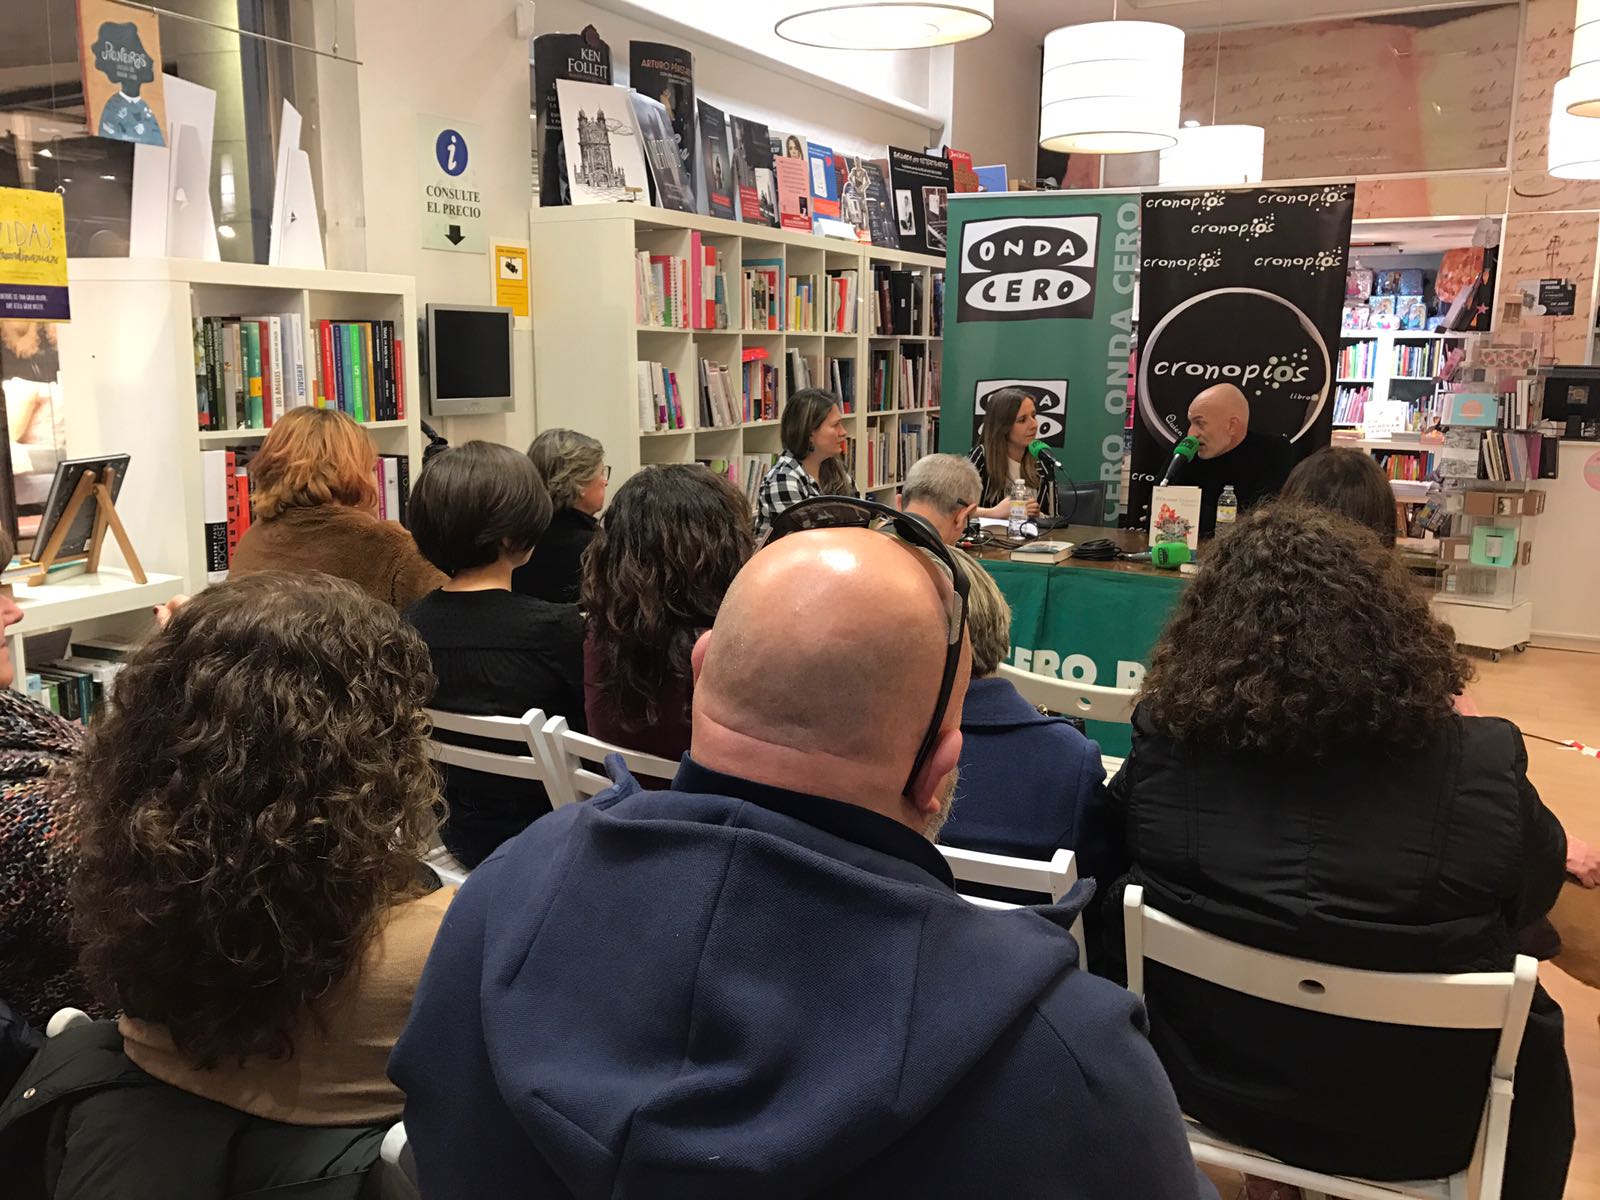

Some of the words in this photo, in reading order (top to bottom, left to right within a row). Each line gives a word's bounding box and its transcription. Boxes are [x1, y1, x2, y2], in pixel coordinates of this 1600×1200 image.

[581, 48, 601, 62] KEN
[640, 59, 670, 71] ARTURO
[568, 58, 608, 79] FOLLETT
[426, 185, 481, 203] CONSULTE
[1146, 191, 1226, 210] cronopios
[1258, 187, 1347, 207] cronopios
[427, 201, 441, 214] EL
[443, 202, 481, 219] PRECIO
[1191, 218, 1275, 237] cronopios
[979, 238, 1076, 261] ONDA
[1113, 202, 1140, 295] CERO
[1143, 253, 1222, 271] cronopios
[1254, 252, 1342, 271] cronopios
[982, 278, 1074, 303] CERO
[1104, 307, 1132, 415] ONDA
[1154, 356, 1310, 387] cronopios
[227, 462, 236, 555] ETXEBARR
[217, 523, 227, 570] BOCUSE
[1008, 646, 1098, 685] ERO
